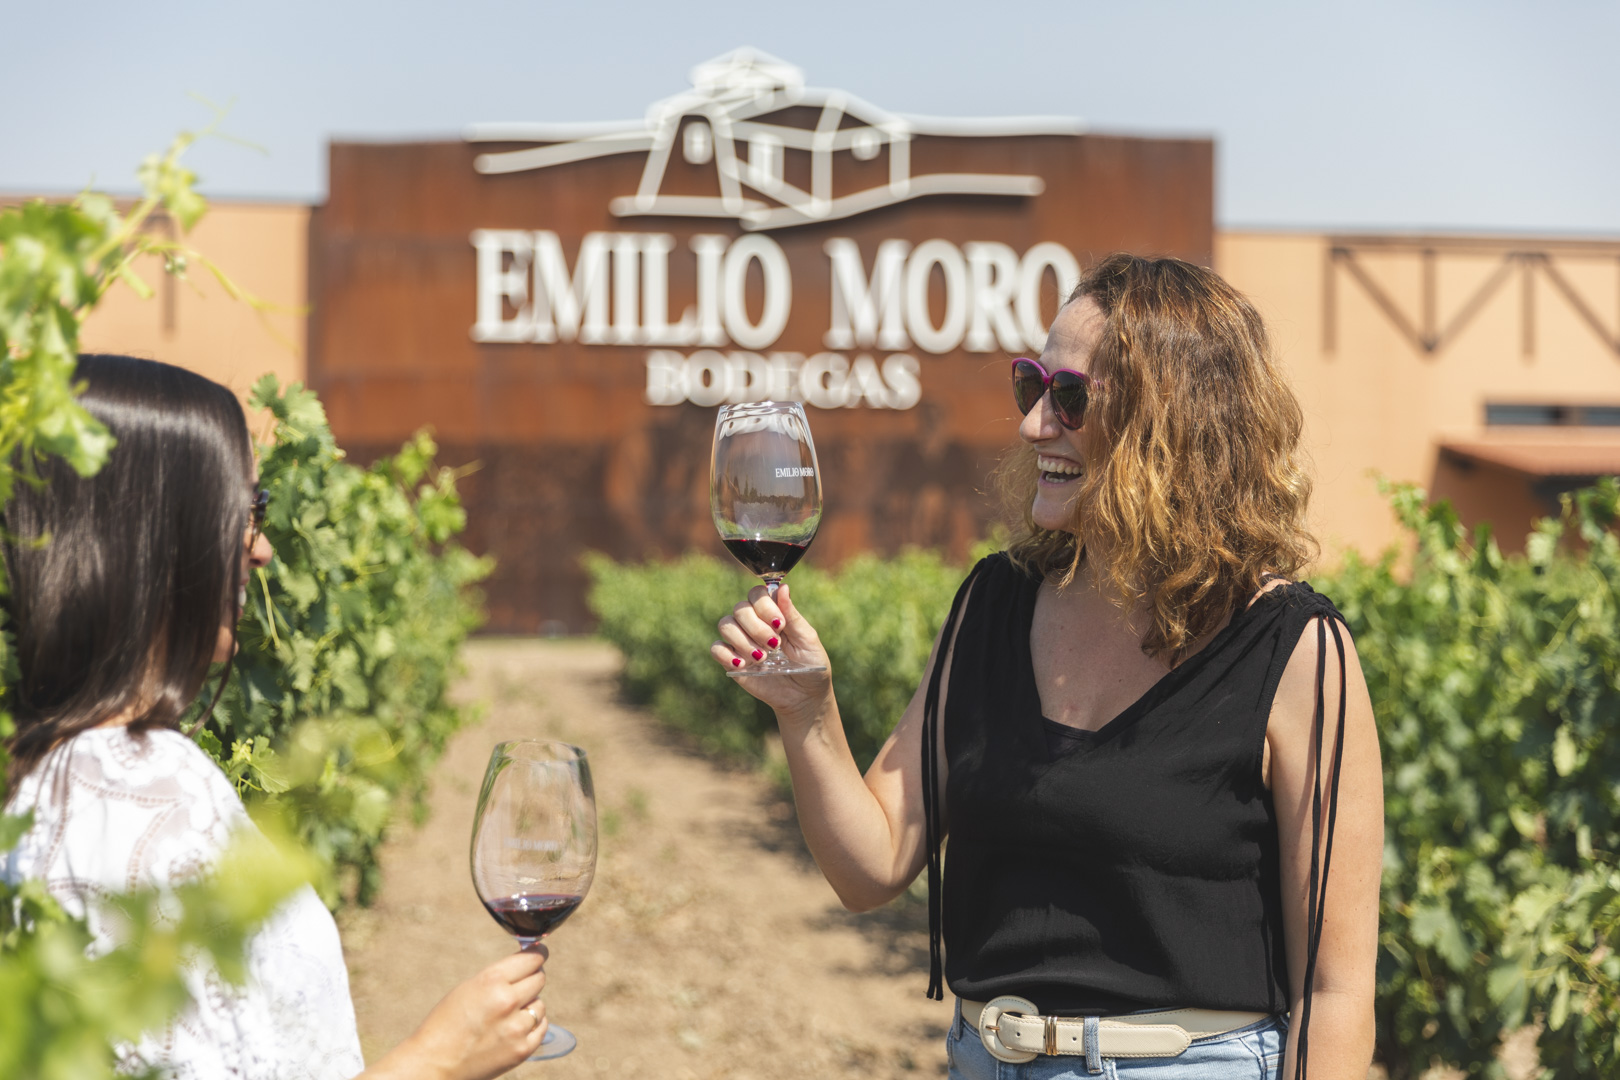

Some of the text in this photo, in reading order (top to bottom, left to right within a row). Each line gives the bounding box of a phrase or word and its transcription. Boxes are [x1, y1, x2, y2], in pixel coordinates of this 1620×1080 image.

[471, 229, 1082, 354] EMILIO MORO
[645, 350, 922, 409] BODEGAS
[775, 467, 800, 478] EMILIO
